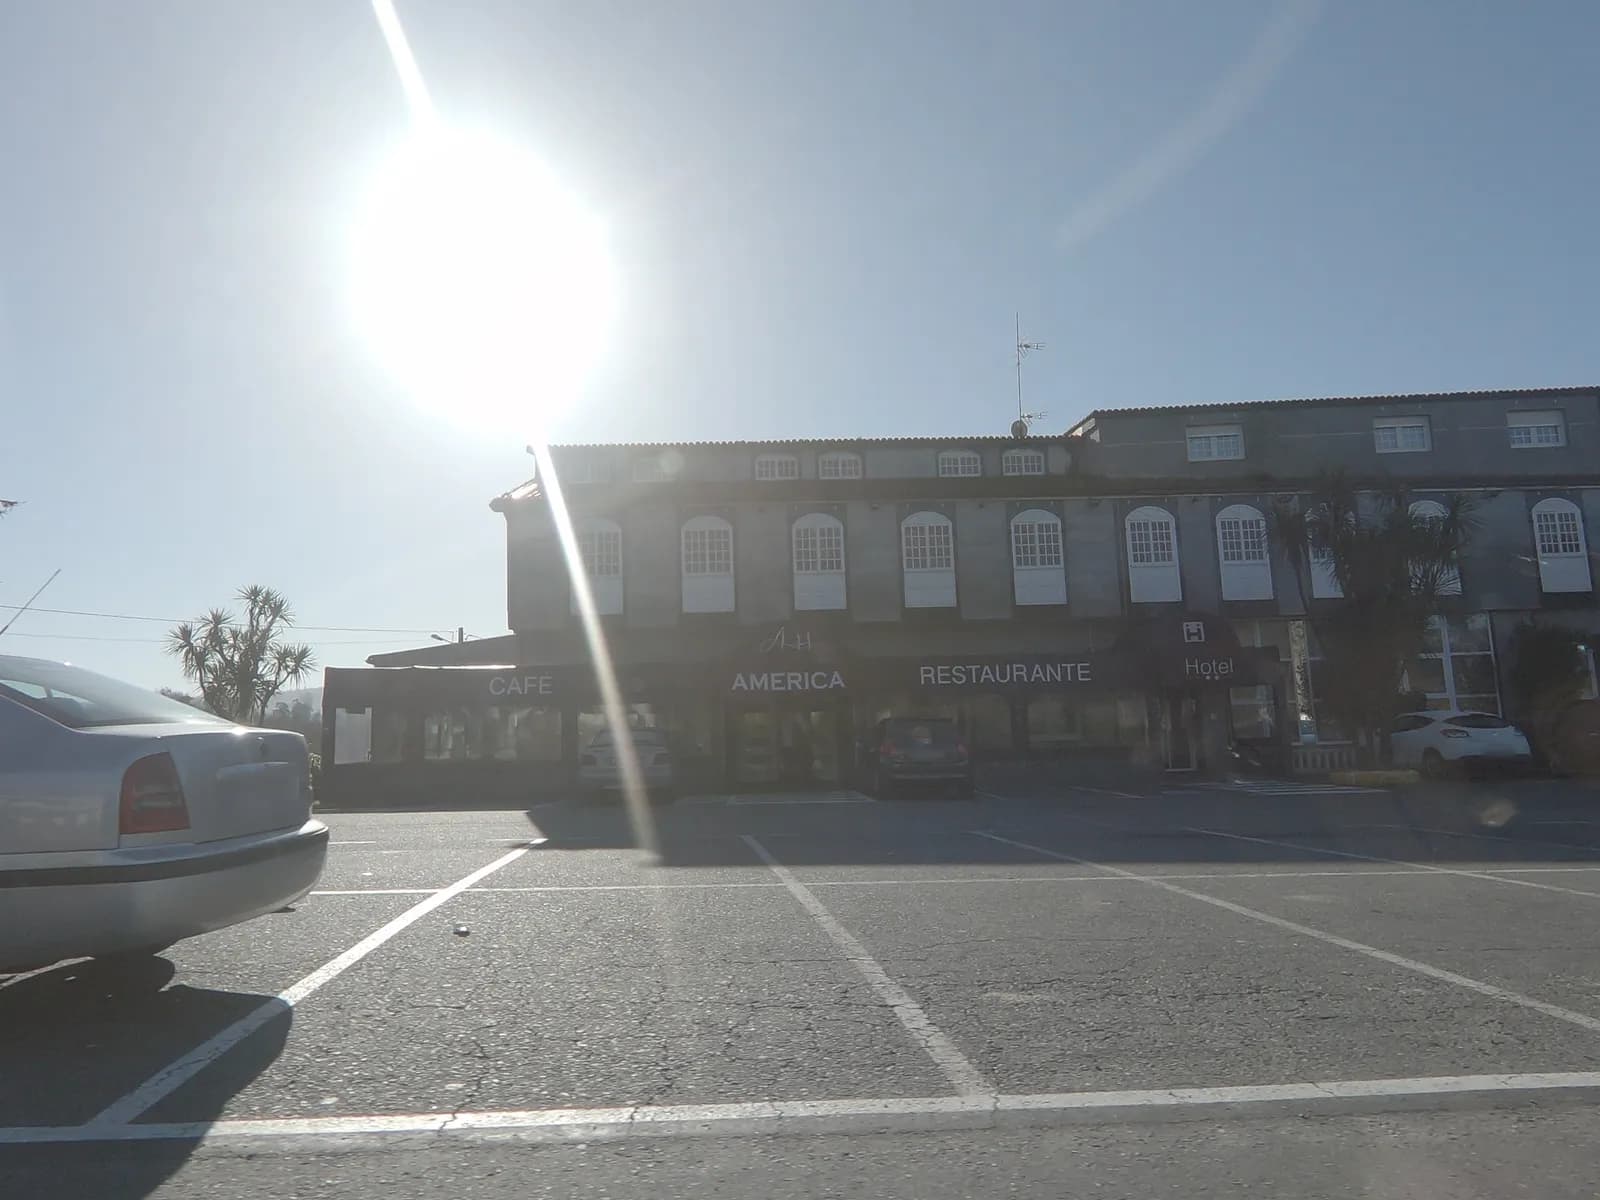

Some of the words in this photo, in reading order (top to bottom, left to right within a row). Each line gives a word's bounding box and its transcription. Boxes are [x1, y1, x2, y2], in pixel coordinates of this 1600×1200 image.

[919, 663, 1092, 685] RESTAURANTE
[1185, 656, 1234, 675] Hotel
[731, 671, 845, 690] AMERICA
